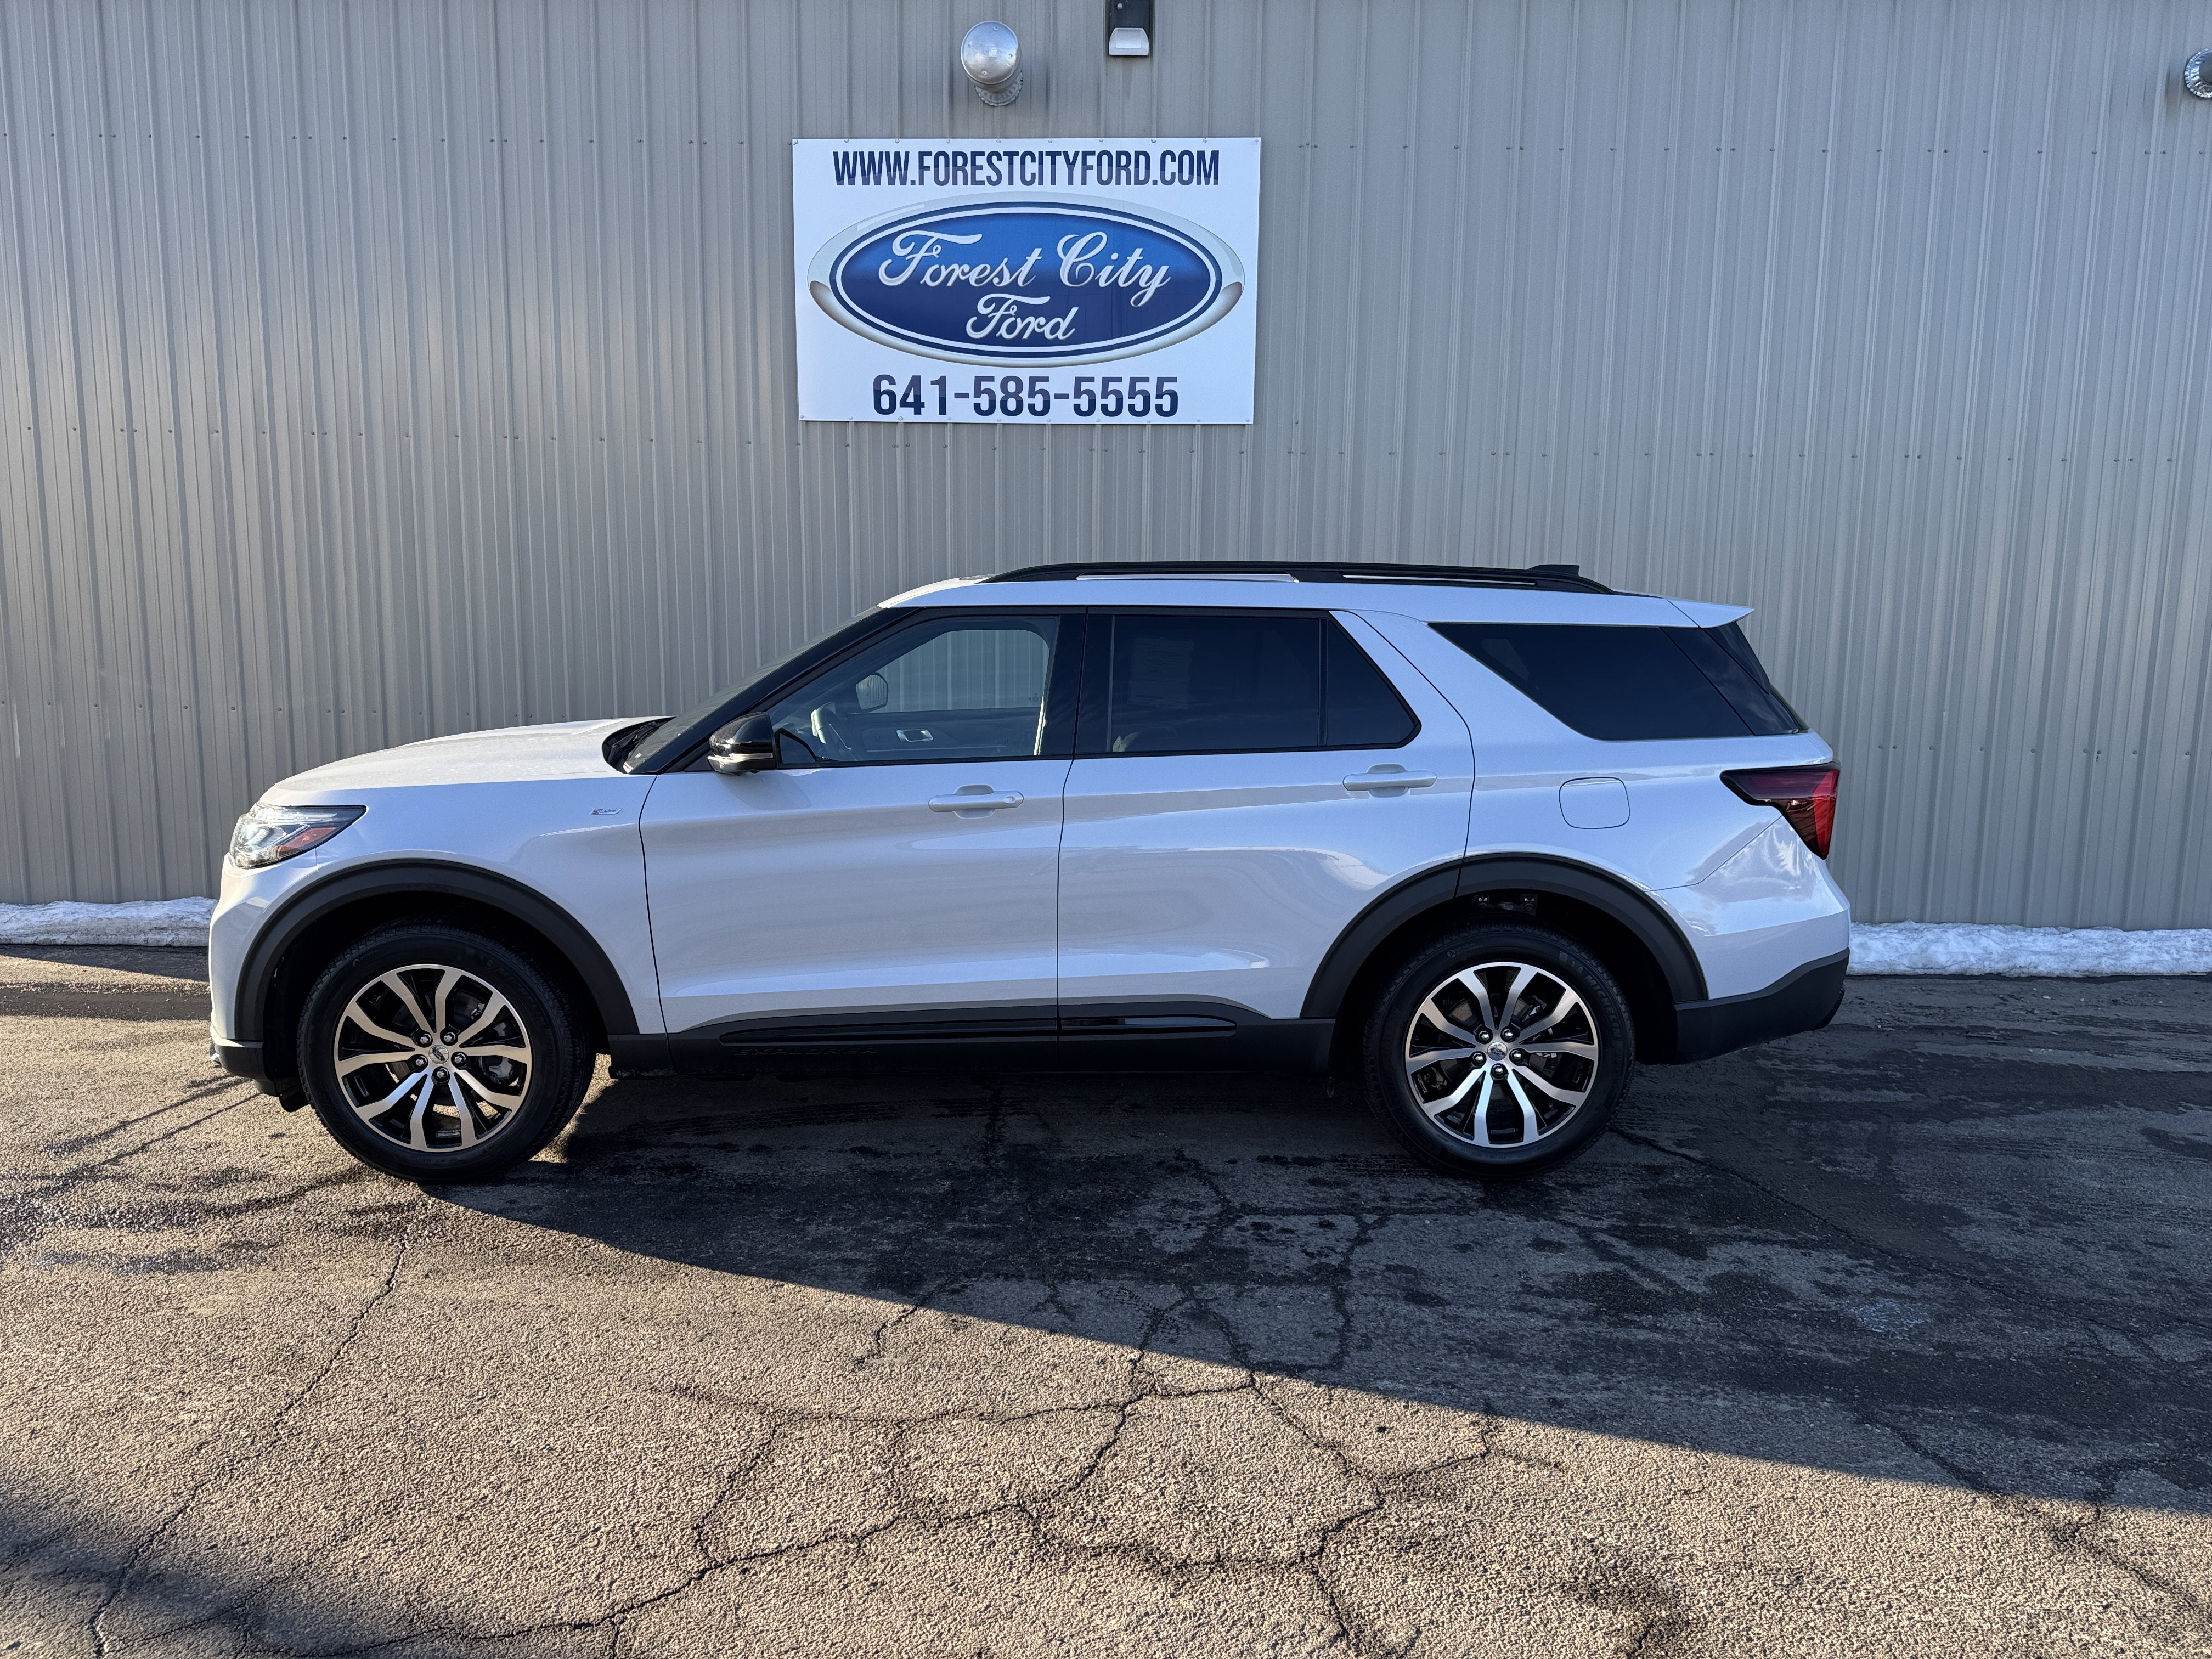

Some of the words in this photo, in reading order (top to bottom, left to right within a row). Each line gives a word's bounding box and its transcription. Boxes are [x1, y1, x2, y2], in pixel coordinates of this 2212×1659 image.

[833, 150, 1220, 186] WWW.FORESTCITYFORD.COM
[878, 230, 1042, 287] Forest
[1057, 232, 1171, 308] City
[966, 293, 1079, 340] Ford
[873, 374, 1178, 417] 641-585-5555
[1584, 975, 1621, 1040] MICHELIN
[733, 1047, 877, 1056] EXPLORER
